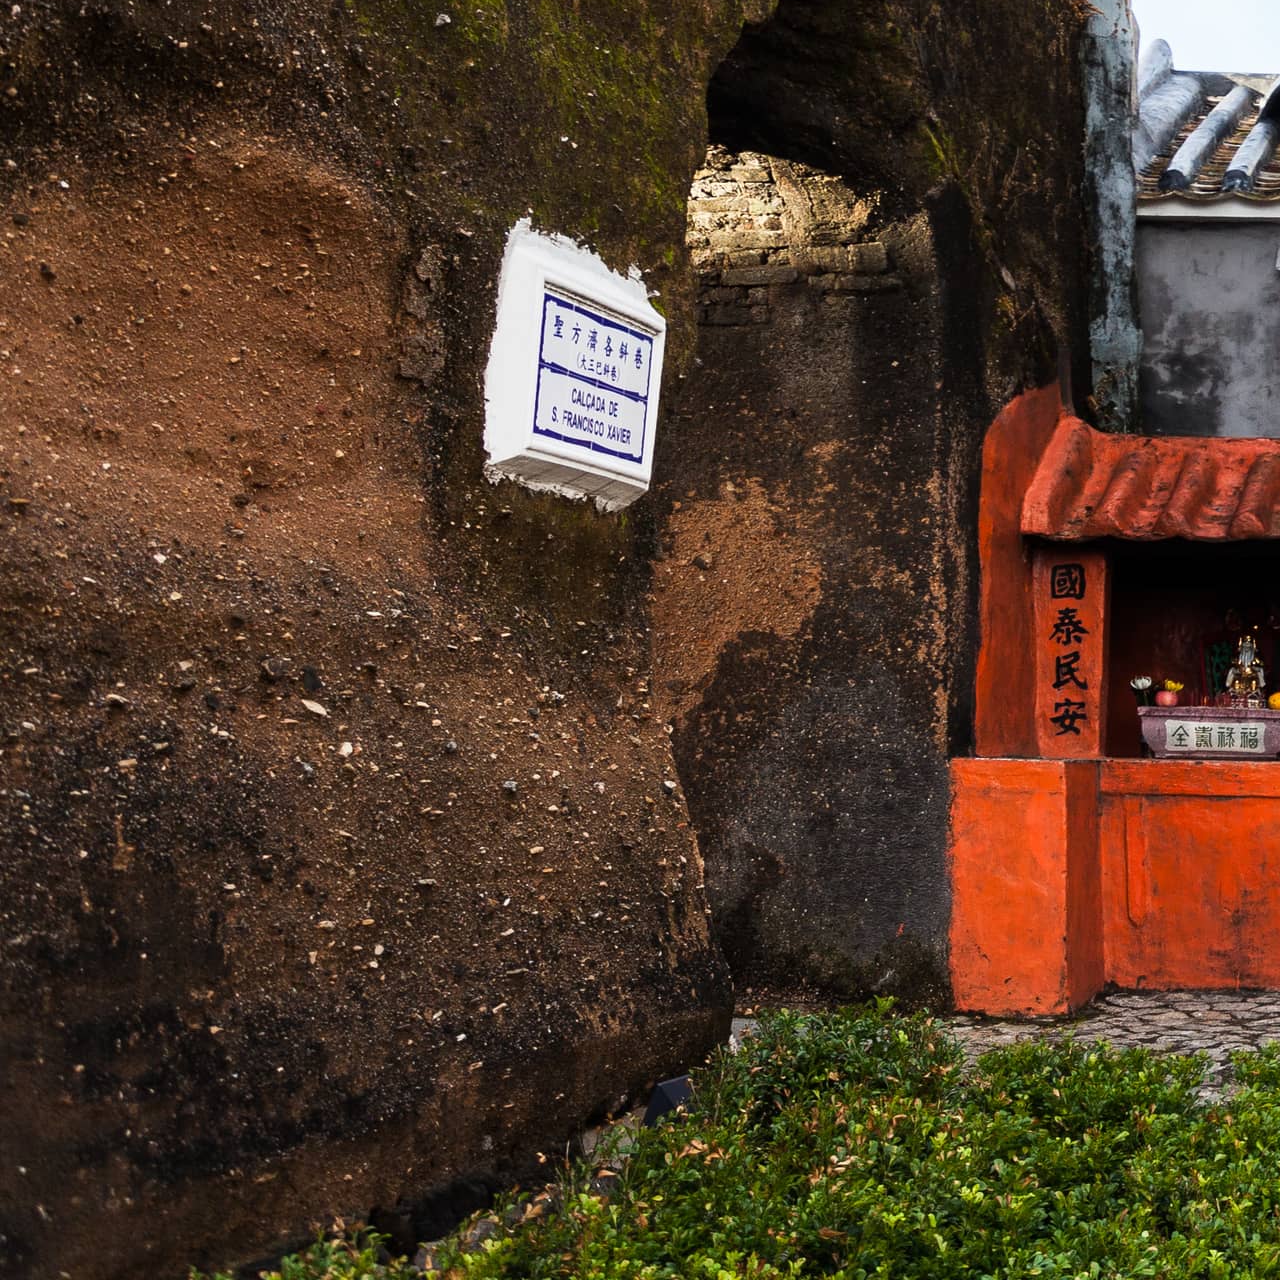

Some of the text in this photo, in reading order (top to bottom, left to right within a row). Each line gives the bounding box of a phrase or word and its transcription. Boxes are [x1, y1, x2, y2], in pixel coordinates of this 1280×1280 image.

[553, 315, 642, 369] 聖方濟各斜巷
[552, 406, 631, 444] S. FRANCISCO XAVIER
[571, 388, 618, 417] CALÇADA DE
[1048, 563, 1090, 737] 國泰民安
